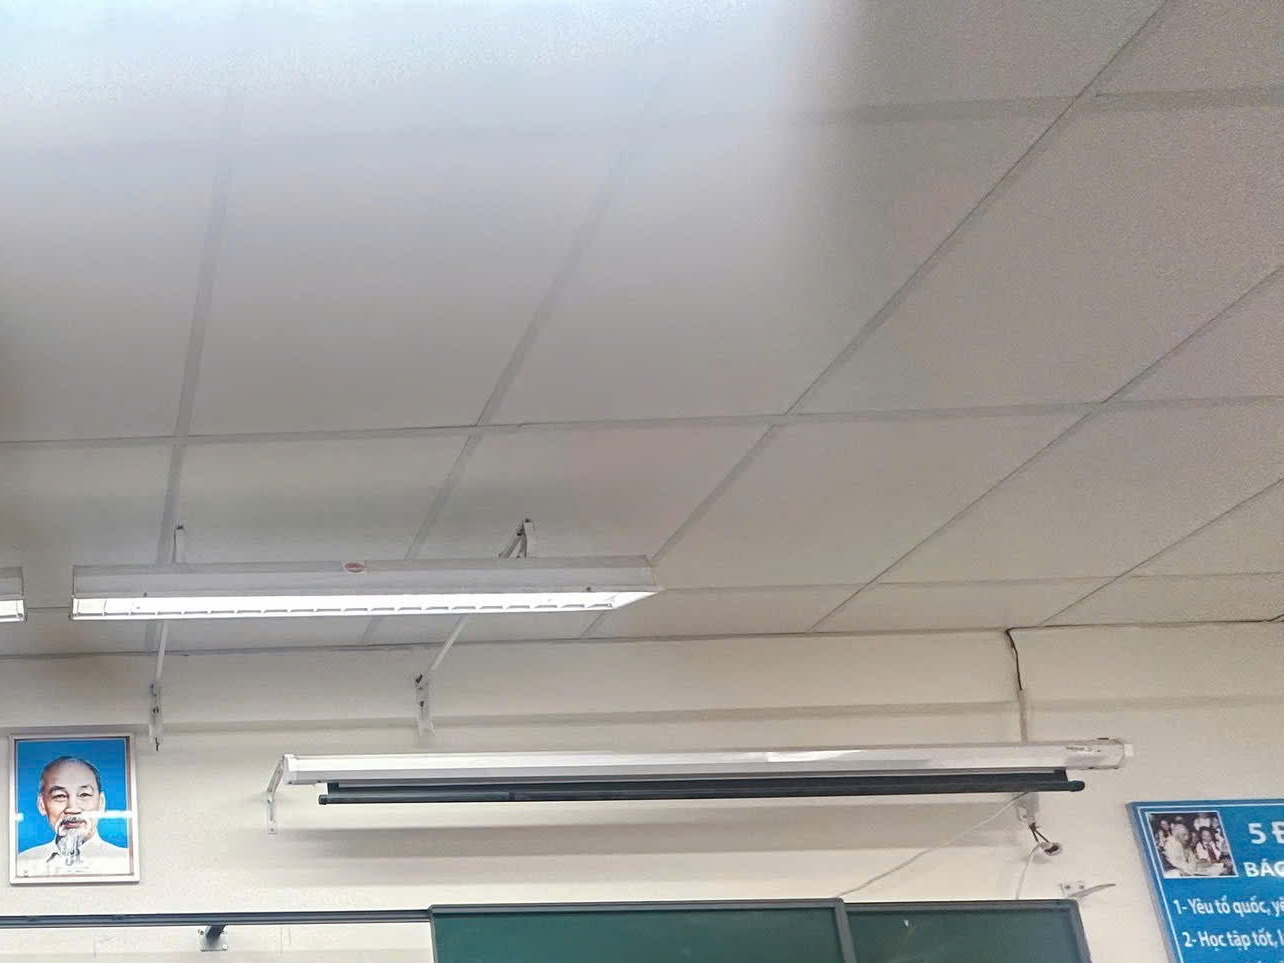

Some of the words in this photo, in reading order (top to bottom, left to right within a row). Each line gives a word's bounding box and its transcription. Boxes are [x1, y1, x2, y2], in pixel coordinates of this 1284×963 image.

[1248, 823, 1266, 844] 5
[1187, 897, 1214, 914] Yêu
[1233, 895, 1271, 917] quốc,
[1198, 931, 1227, 951] Học
[1227, 930, 1251, 951] tập
[1252, 927, 1277, 949] tốt,
